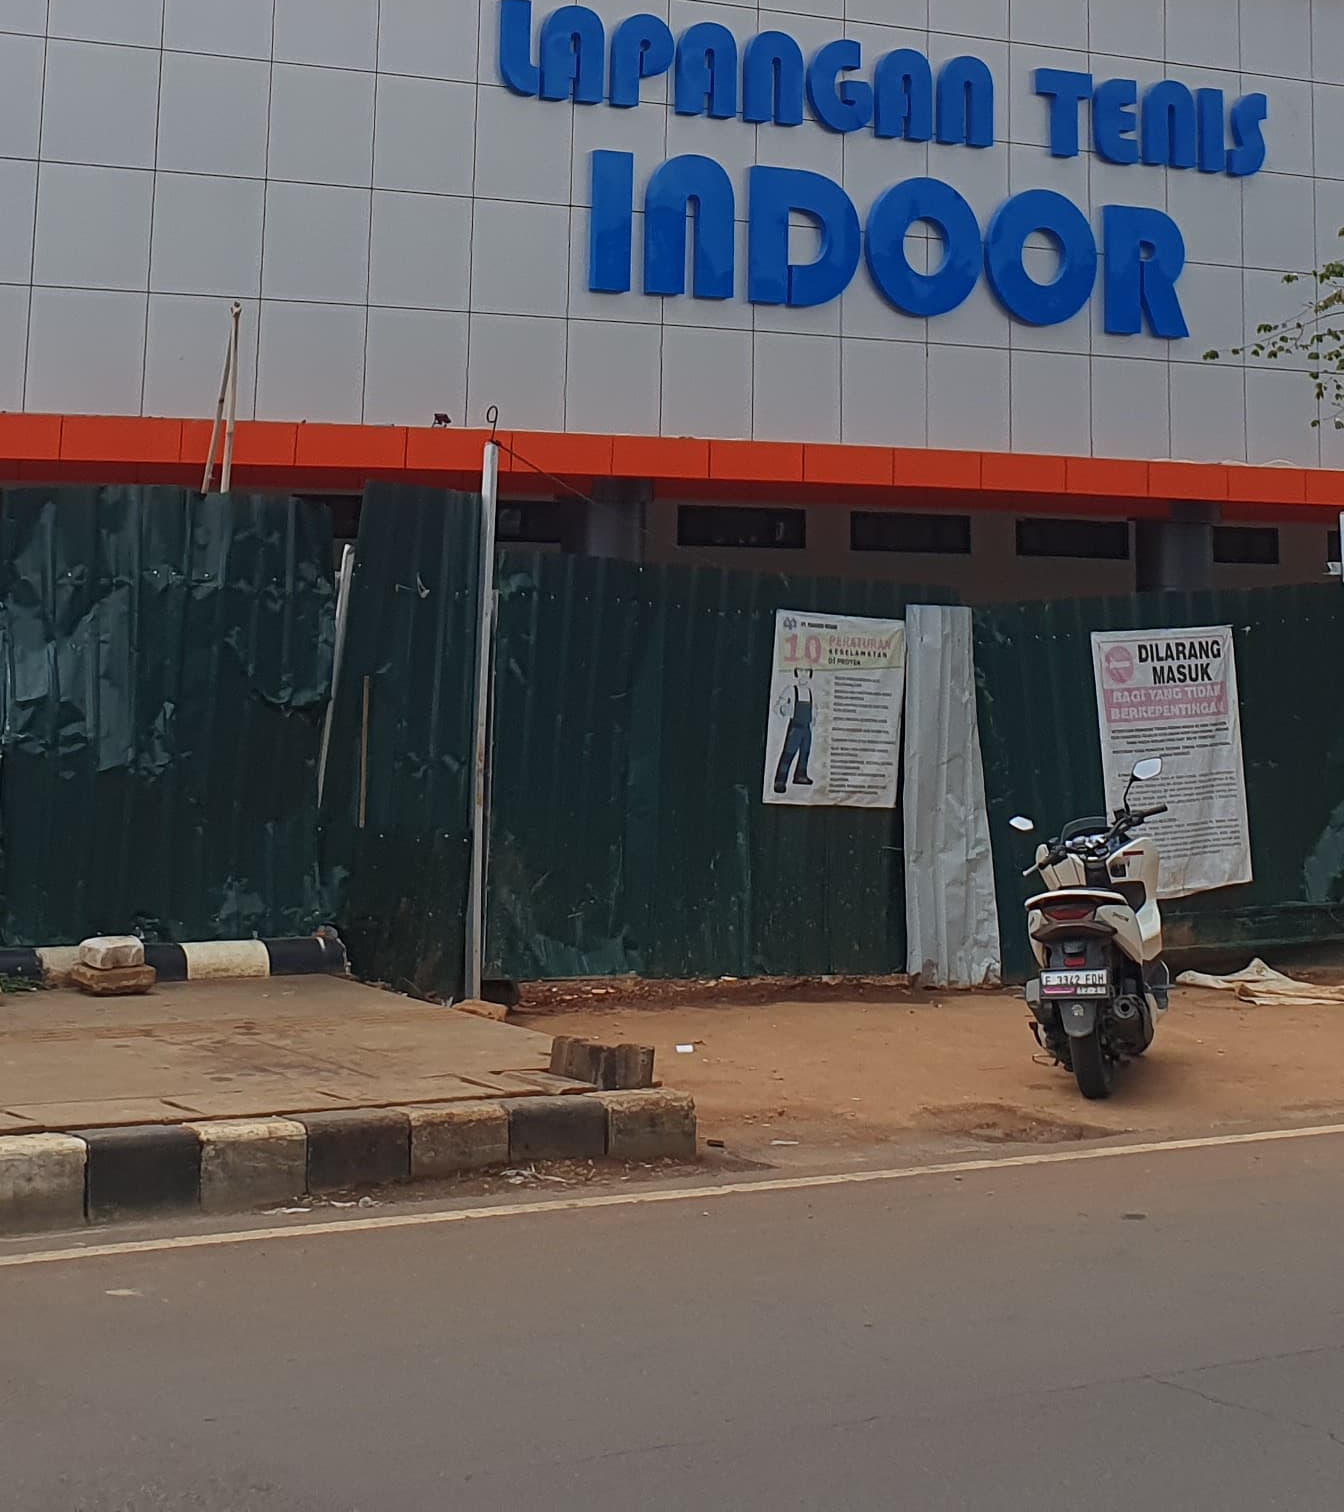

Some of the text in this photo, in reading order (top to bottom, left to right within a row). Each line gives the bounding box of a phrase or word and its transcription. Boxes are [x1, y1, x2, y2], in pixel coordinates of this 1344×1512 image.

[1034, 66, 1268, 178] TENIS
[588, 149, 1190, 340] INDOOR
[784, 633, 822, 665] 10
[829, 634, 891, 649] PERATURAN
[1137, 639, 1222, 664] DILARANG
[828, 649, 888, 659] KESELAMATAN
[1152, 663, 1213, 685] MASUK
[1113, 685, 1221, 704] BAGI YANG TIDAK
